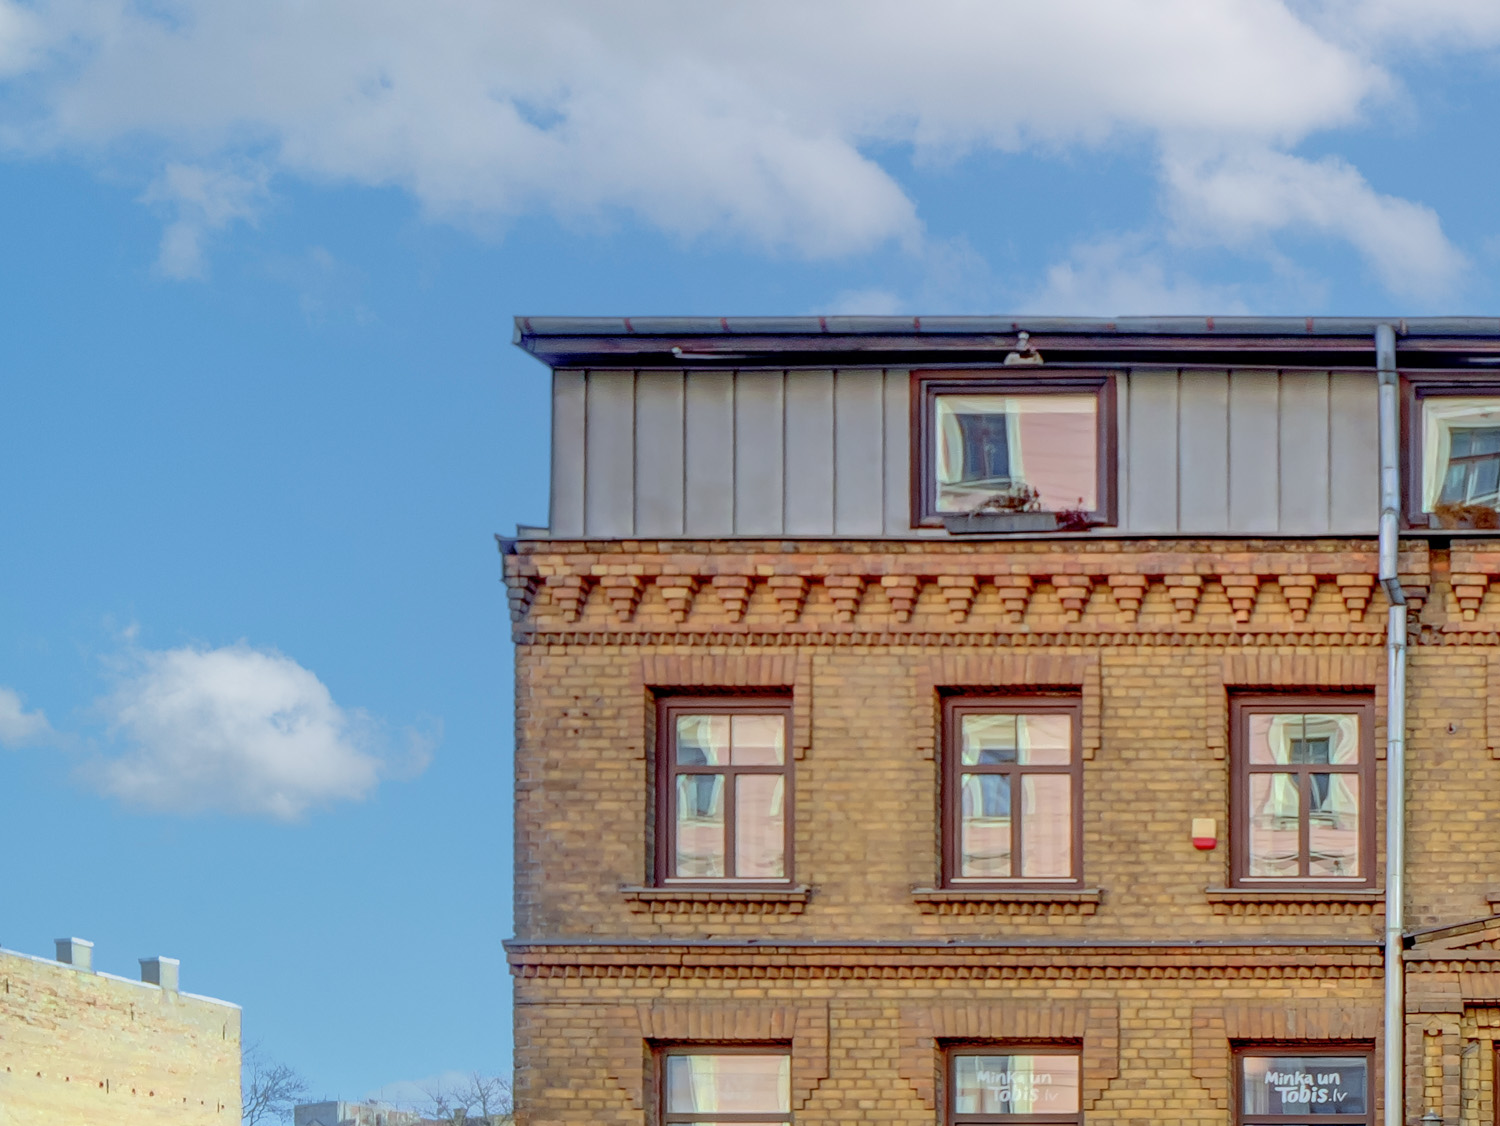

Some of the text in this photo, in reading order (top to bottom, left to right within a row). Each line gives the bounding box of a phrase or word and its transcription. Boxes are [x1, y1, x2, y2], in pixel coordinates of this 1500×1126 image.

[977, 1070, 1052, 1085] Minka un
[1264, 1070, 1340, 1086] Minka un
[1274, 1085, 1348, 1103] Tobis.lv
